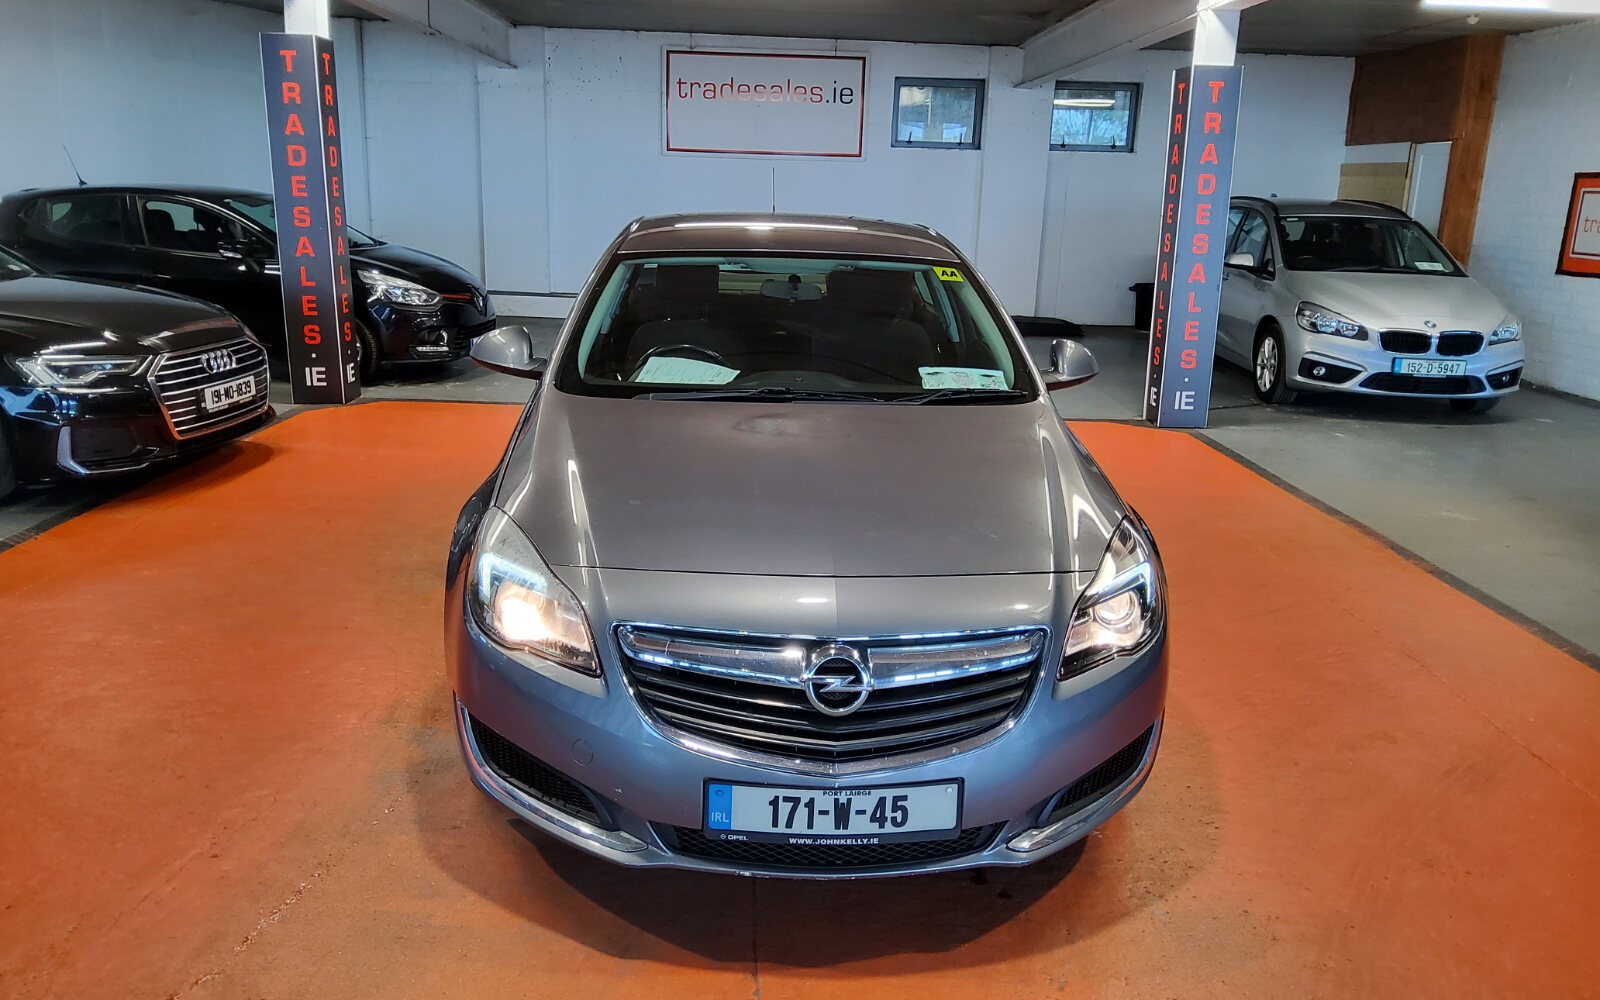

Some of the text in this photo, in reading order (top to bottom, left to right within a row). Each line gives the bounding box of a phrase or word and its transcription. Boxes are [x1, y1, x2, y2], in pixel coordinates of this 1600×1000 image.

[676, 76, 854, 105] tradesales.ie
[941, 269, 958, 278] AA
[1407, 362, 1461, 375] 152-D-5947
[711, 811, 729, 823] IRL
[768, 794, 909, 831] 171-W-45
[788, 837, 880, 845] WWW.JOHNKELLY.IE
